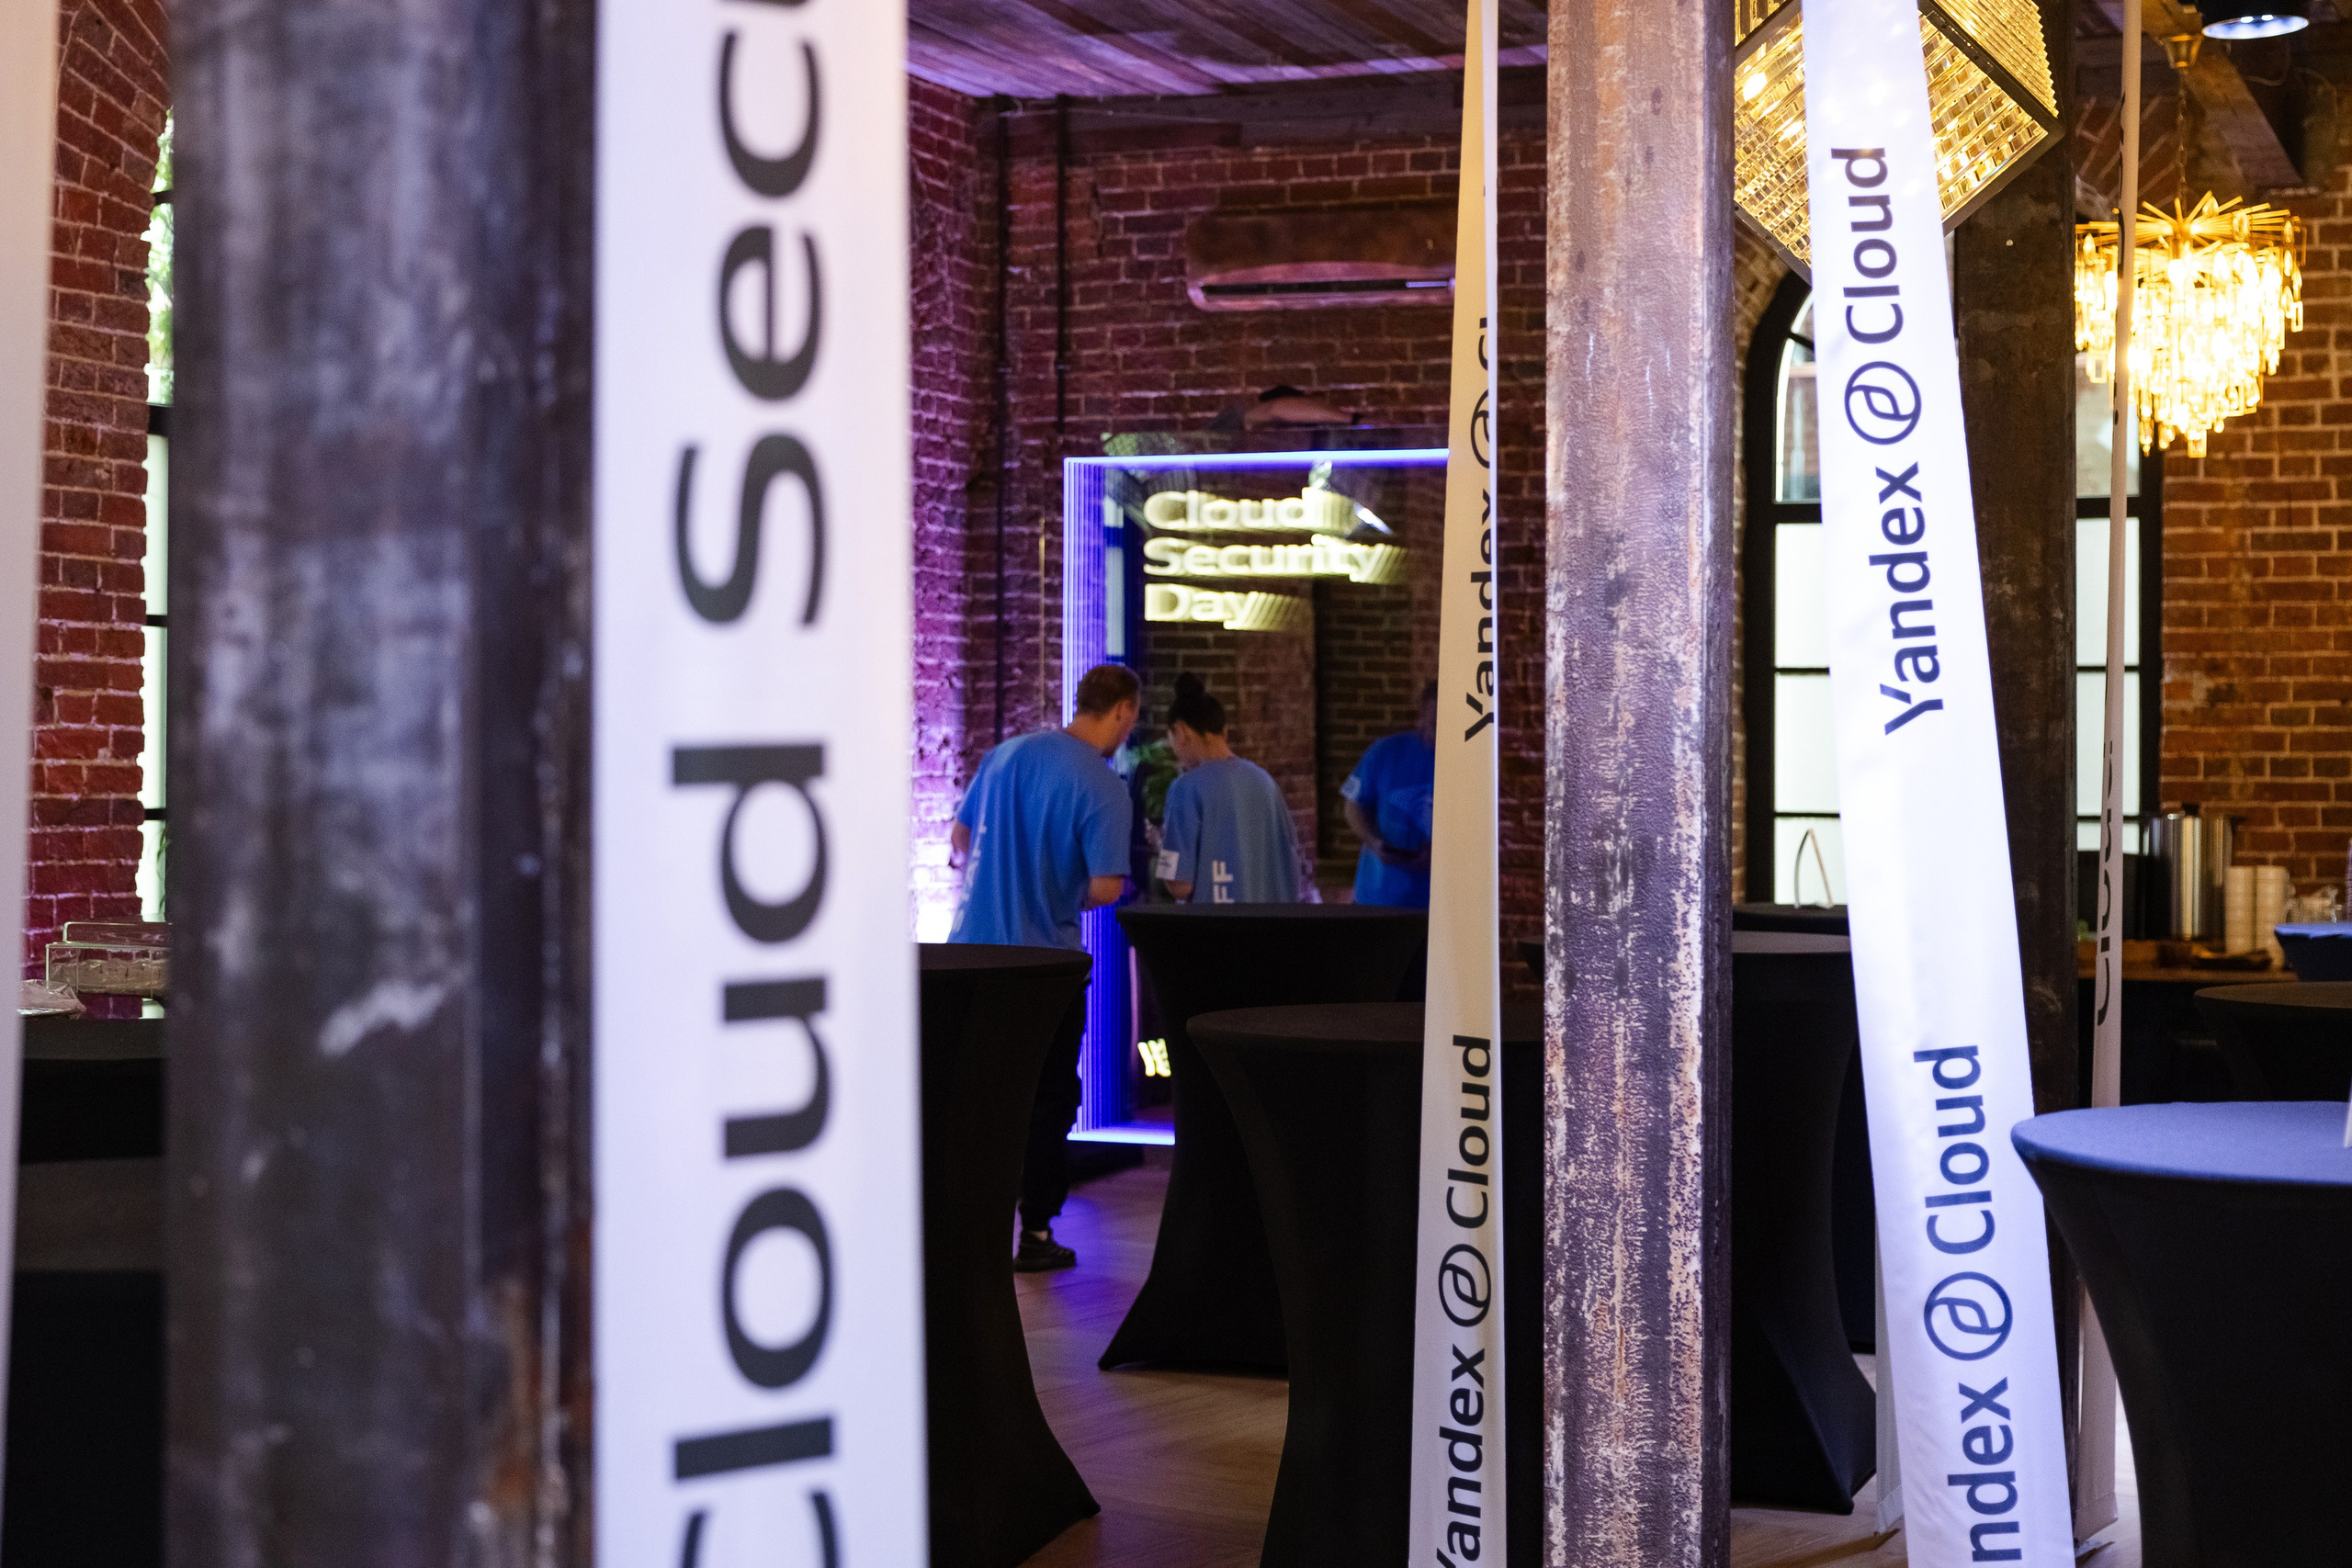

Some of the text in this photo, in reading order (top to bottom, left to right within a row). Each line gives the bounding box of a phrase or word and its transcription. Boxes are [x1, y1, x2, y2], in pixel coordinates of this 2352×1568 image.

[673, 0, 826, 628] Sec
[1144, 486, 1334, 532] Cloud
[1830, 146, 1944, 735] Yandex Cloud
[1144, 533, 1389, 583] Security
[1144, 582, 1275, 631] Day
[1445, 1034, 1492, 1229] Cloud
[1913, 1044, 1996, 1256] Cloud
